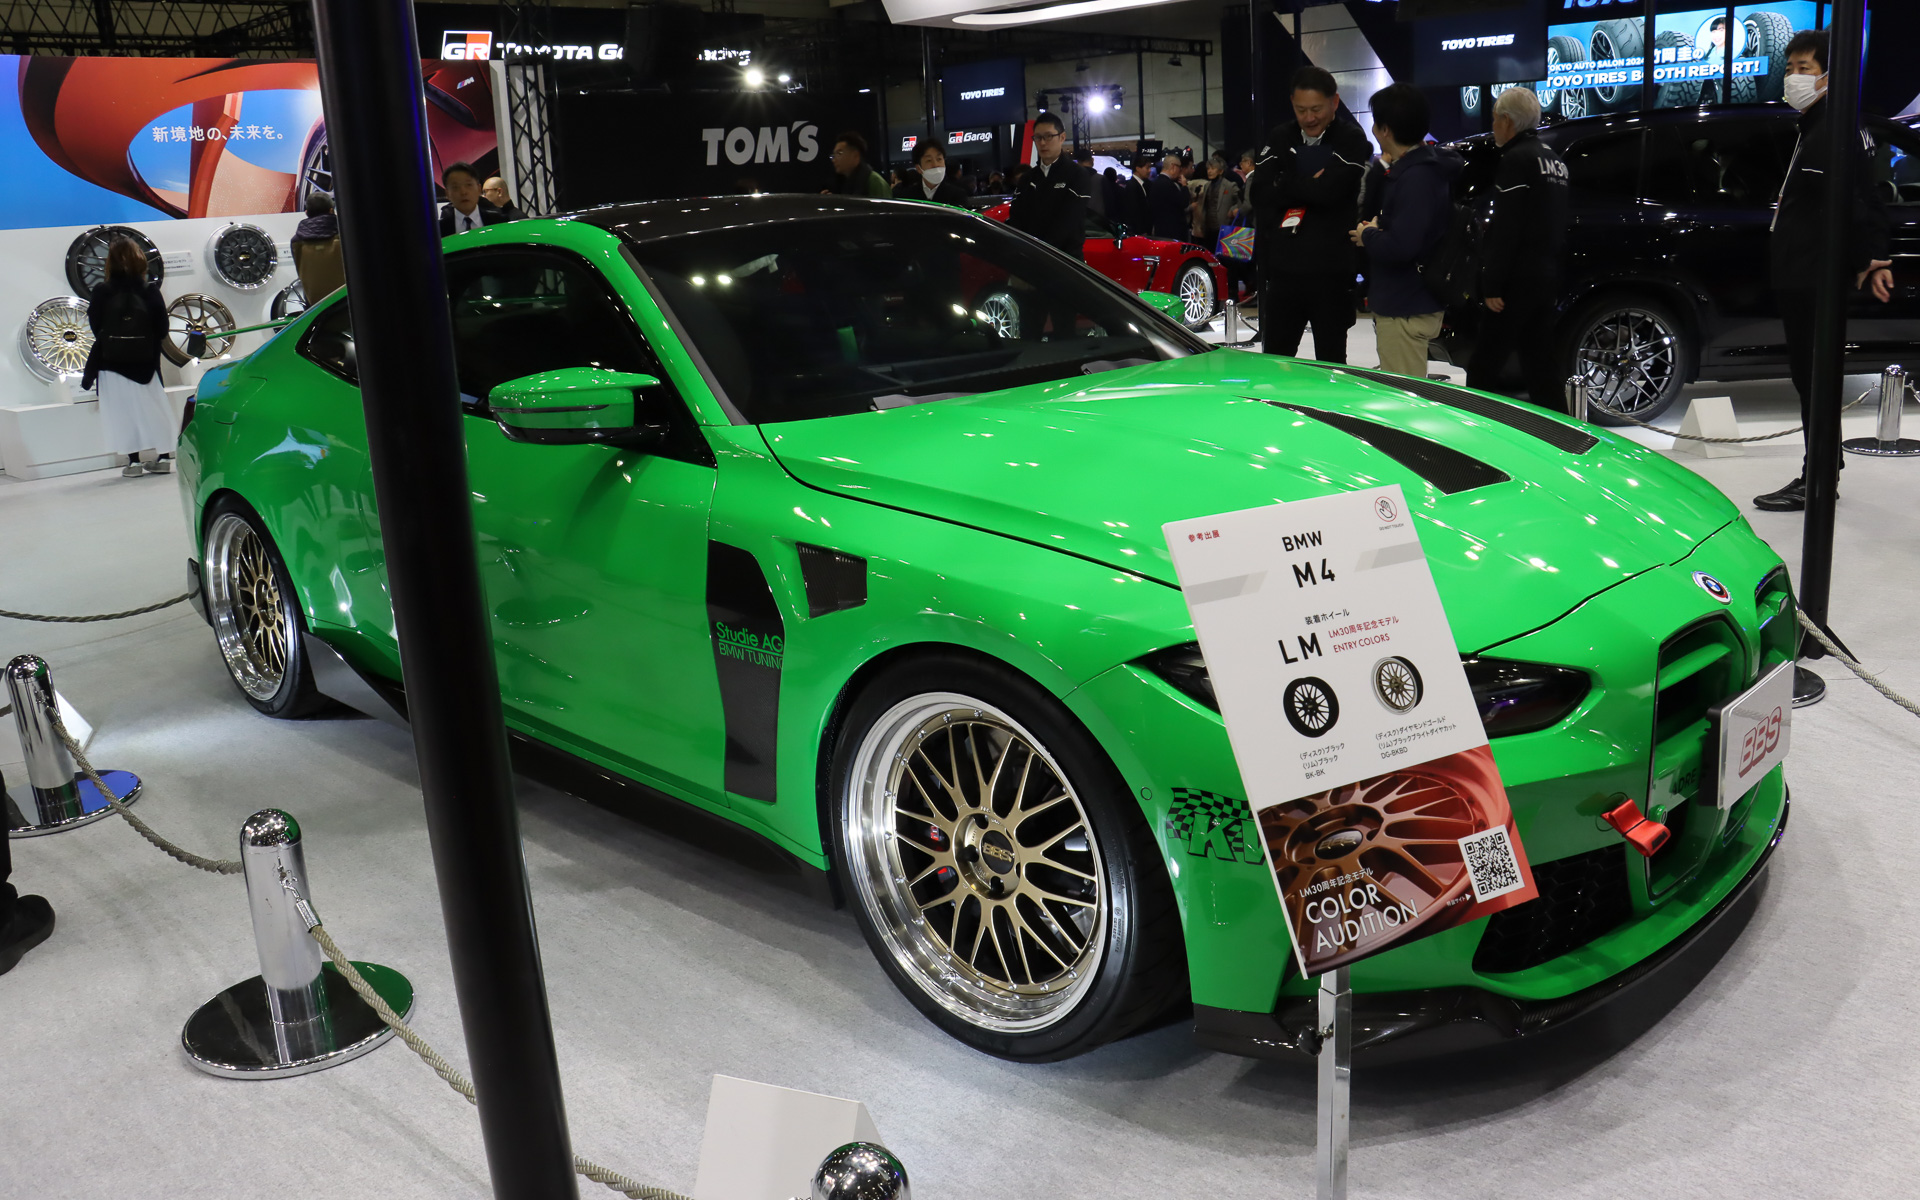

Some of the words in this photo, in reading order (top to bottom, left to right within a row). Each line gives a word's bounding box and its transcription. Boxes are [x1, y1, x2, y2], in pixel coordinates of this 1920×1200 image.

[442, 42, 491, 60] GR
[1442, 39, 1476, 50] TOYO
[1477, 34, 1515, 47] TIRES
[1573, 61, 1596, 70] AUTO
[1597, 58, 1624, 68] SALON
[1547, 74, 1583, 87] TOYO
[1585, 71, 1627, 85] TIRES
[1631, 66, 1686, 81] BOTH
[960, 91, 980, 100] TOYO
[981, 88, 1005, 98] TIRES
[152, 124, 284, 143] 新境地の、未来を。
[702, 121, 819, 166] TOM'S
[1188, 529, 1220, 543] 参考出展
[1281, 530, 1322, 552] BMW
[1292, 558, 1335, 588] M4
[1304, 609, 1350, 625] 装着ホイール
[1328, 616, 1399, 638] LM30周年記念モデル
[716, 621, 758, 647] Studie
[762, 633, 783, 653] AG
[1333, 640, 1358, 653] ENTRY
[1358, 633, 1390, 647] COLORS
[719, 642, 744, 661] BMW
[1278, 632, 1323, 664] LM
[1738, 706, 1782, 778] BBS
[1305, 769, 1325, 779] BK-BK
[983, 842, 1015, 863] BBS
[1299, 868, 1374, 898] LM30周年記念モデル
[1306, 883, 1381, 924] COLOR
[1317, 898, 1419, 953] AUDITION
